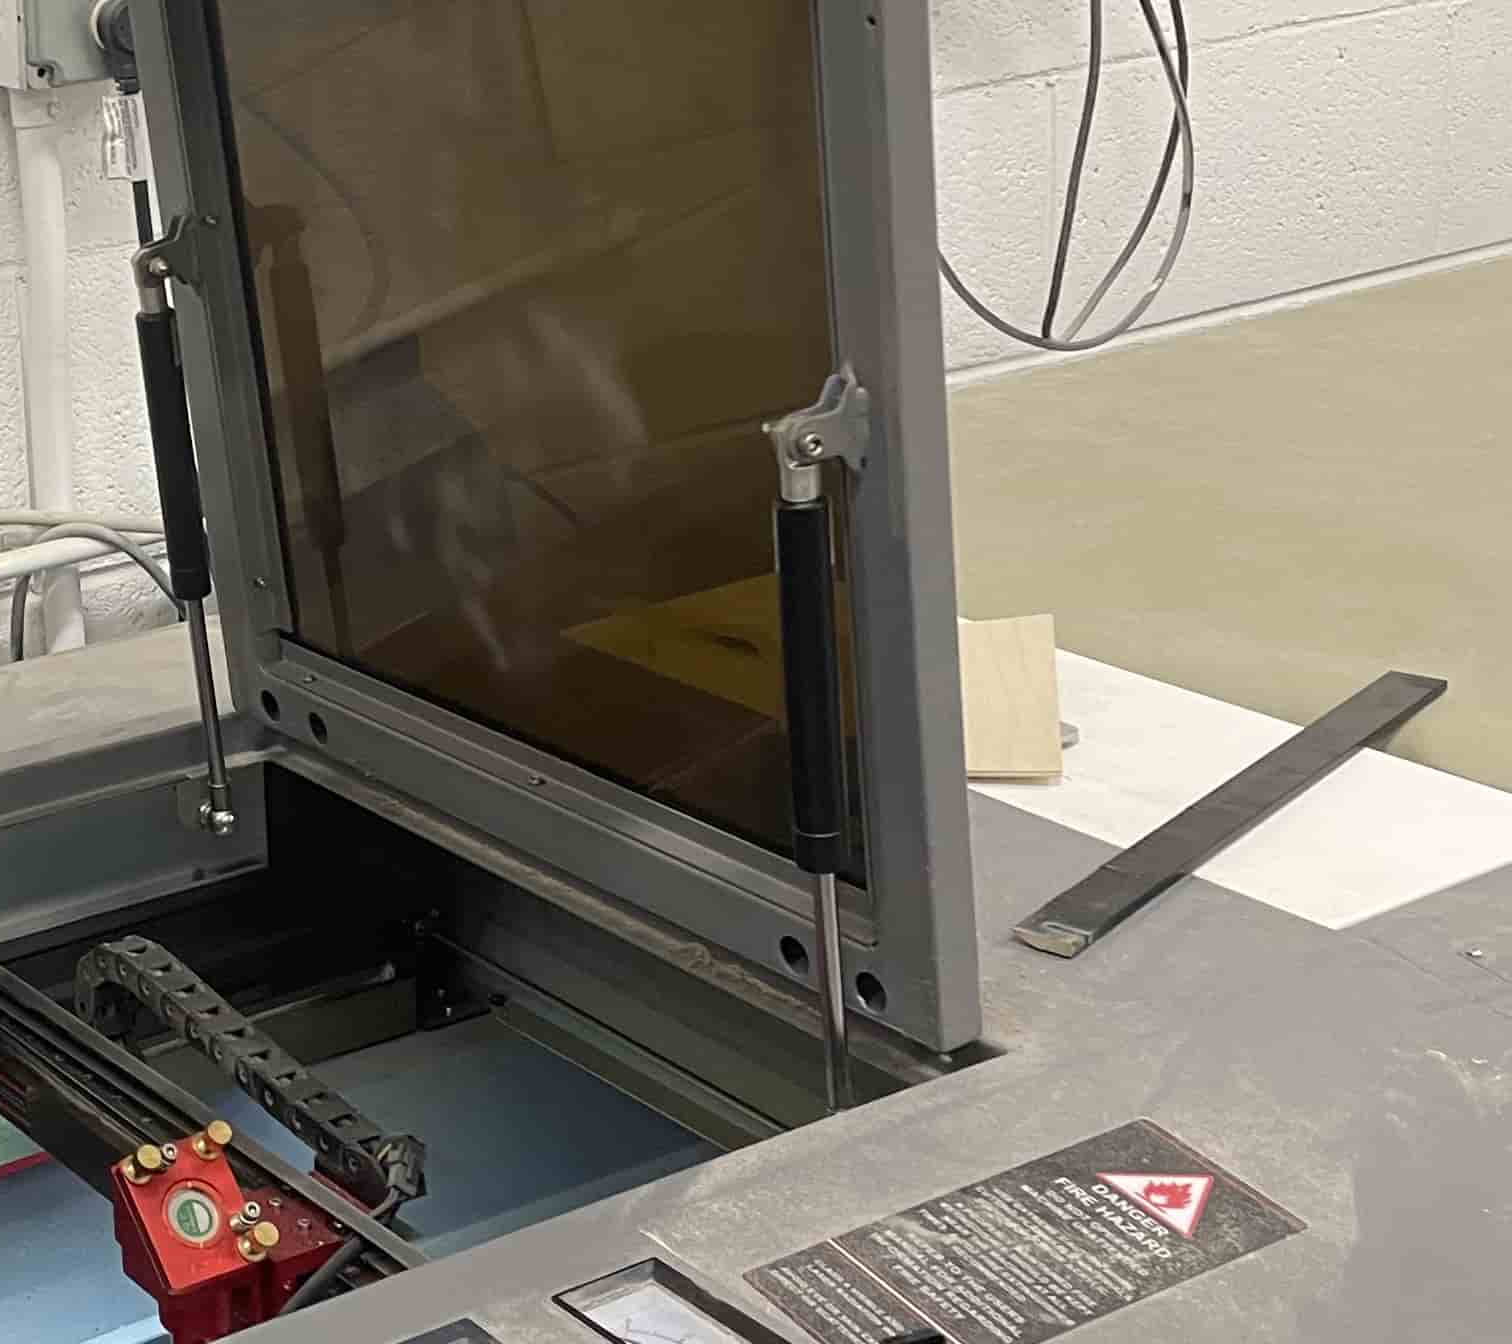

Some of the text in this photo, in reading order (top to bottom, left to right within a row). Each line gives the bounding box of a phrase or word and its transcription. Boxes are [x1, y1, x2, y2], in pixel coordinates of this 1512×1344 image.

[1053, 1176, 1099, 1206] FIRE
[1095, 1207, 1172, 1258] HAZARD
[1091, 1183, 1170, 1237] DANGER
